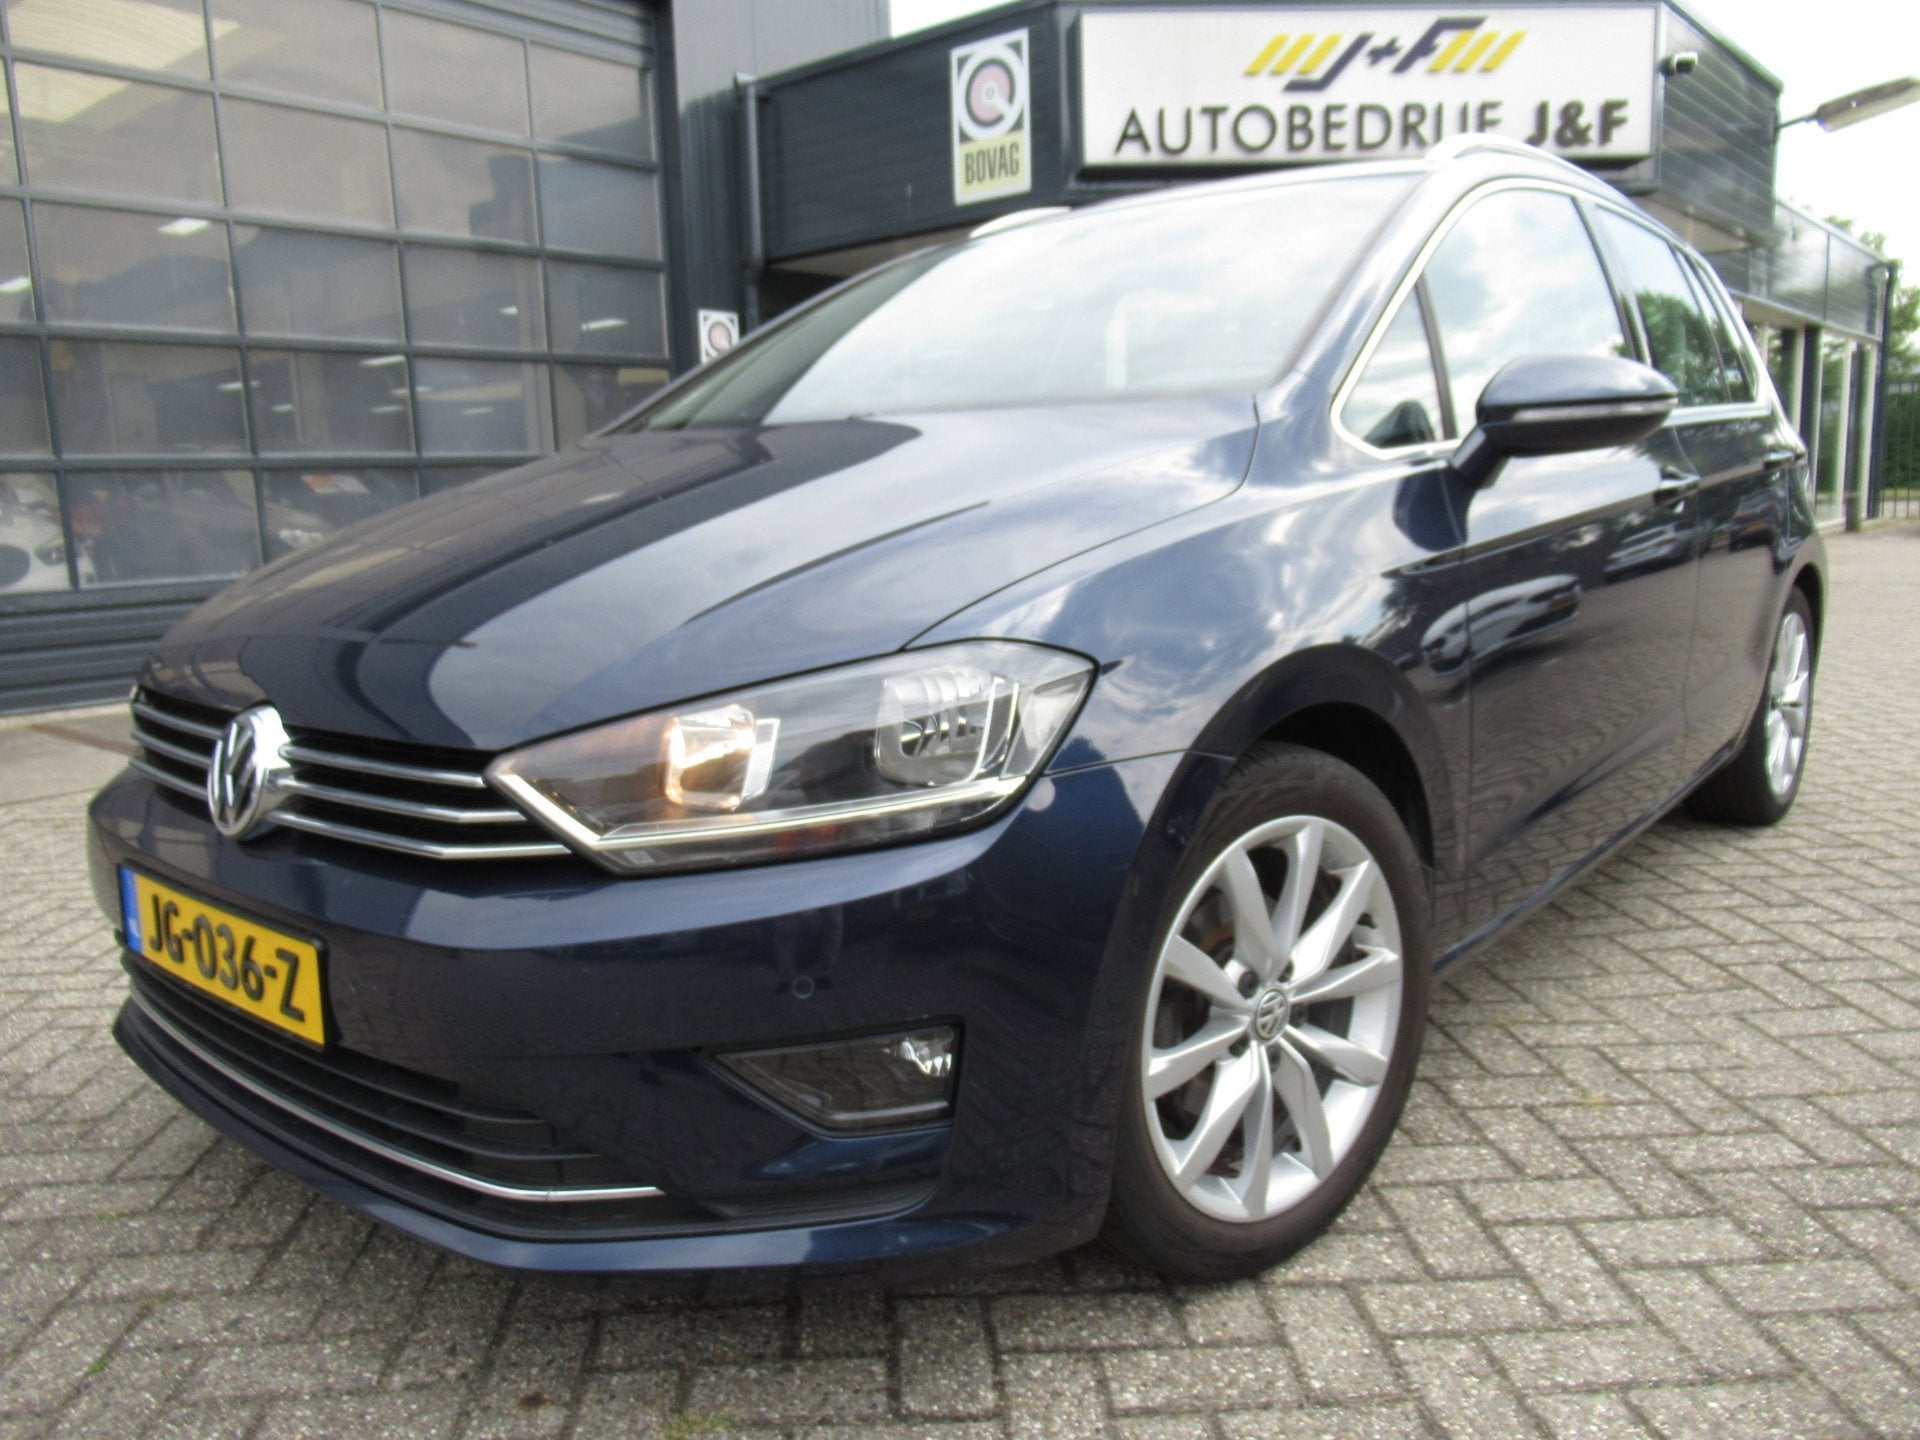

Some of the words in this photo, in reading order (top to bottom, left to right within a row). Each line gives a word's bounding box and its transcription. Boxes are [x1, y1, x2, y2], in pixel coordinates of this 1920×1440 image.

[1525, 99, 1629, 147] J&F
[965, 142, 1020, 185] BOVAG
[150, 893, 306, 1023] JG-036-Z
